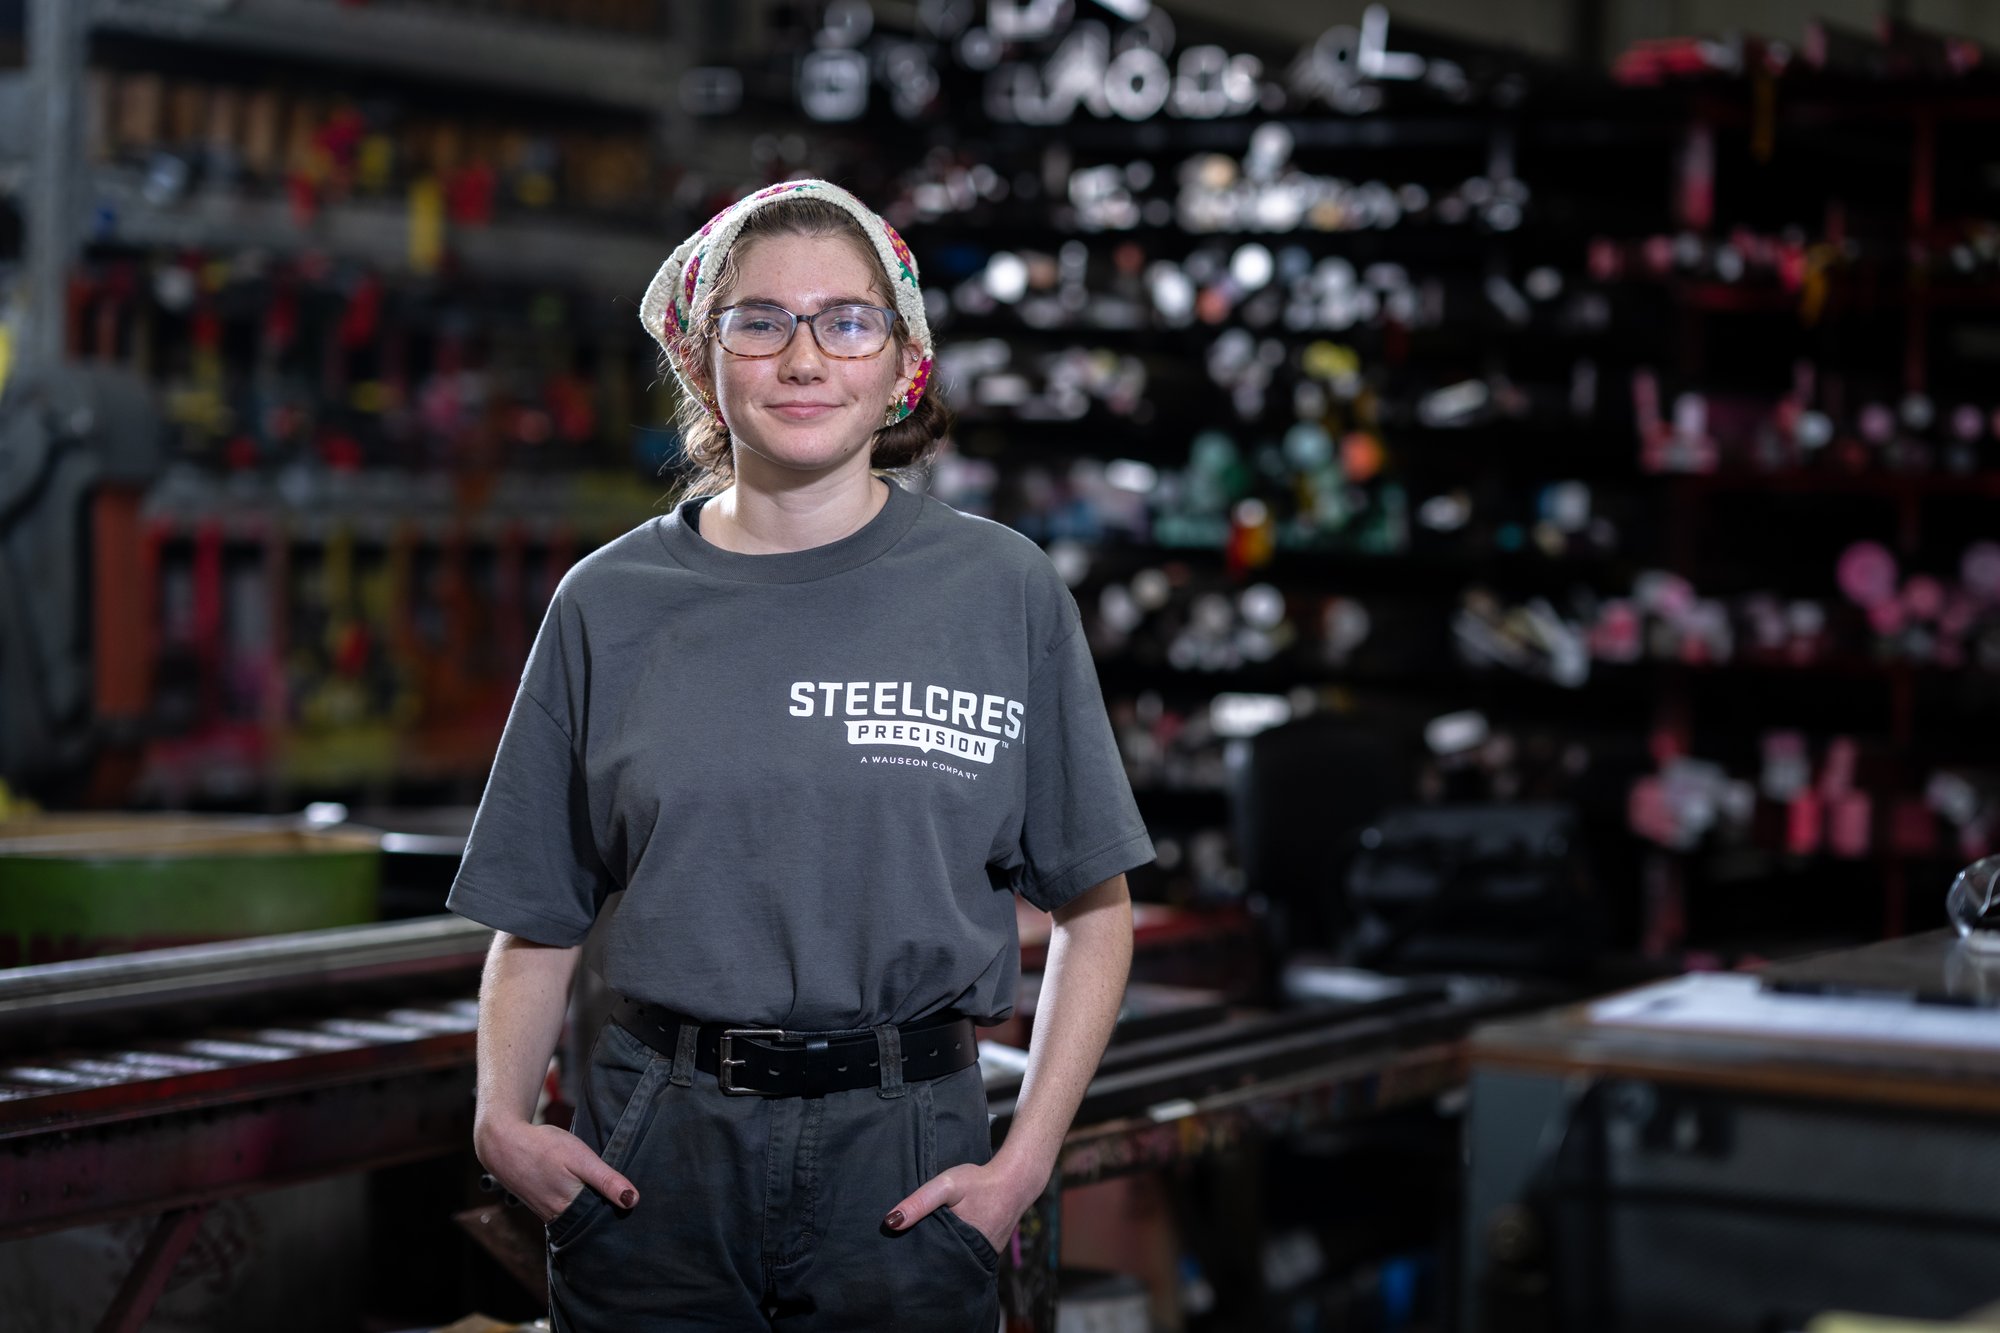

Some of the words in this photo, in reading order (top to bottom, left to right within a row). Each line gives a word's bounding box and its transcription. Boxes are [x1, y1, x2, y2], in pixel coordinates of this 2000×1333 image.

[789, 681, 1026, 744] STEELCRES
[858, 725, 986, 757] PRECISION
[860, 756, 868, 764] A
[872, 756, 928, 767] WAUSEON
[932, 761, 978, 780] COMPANY
